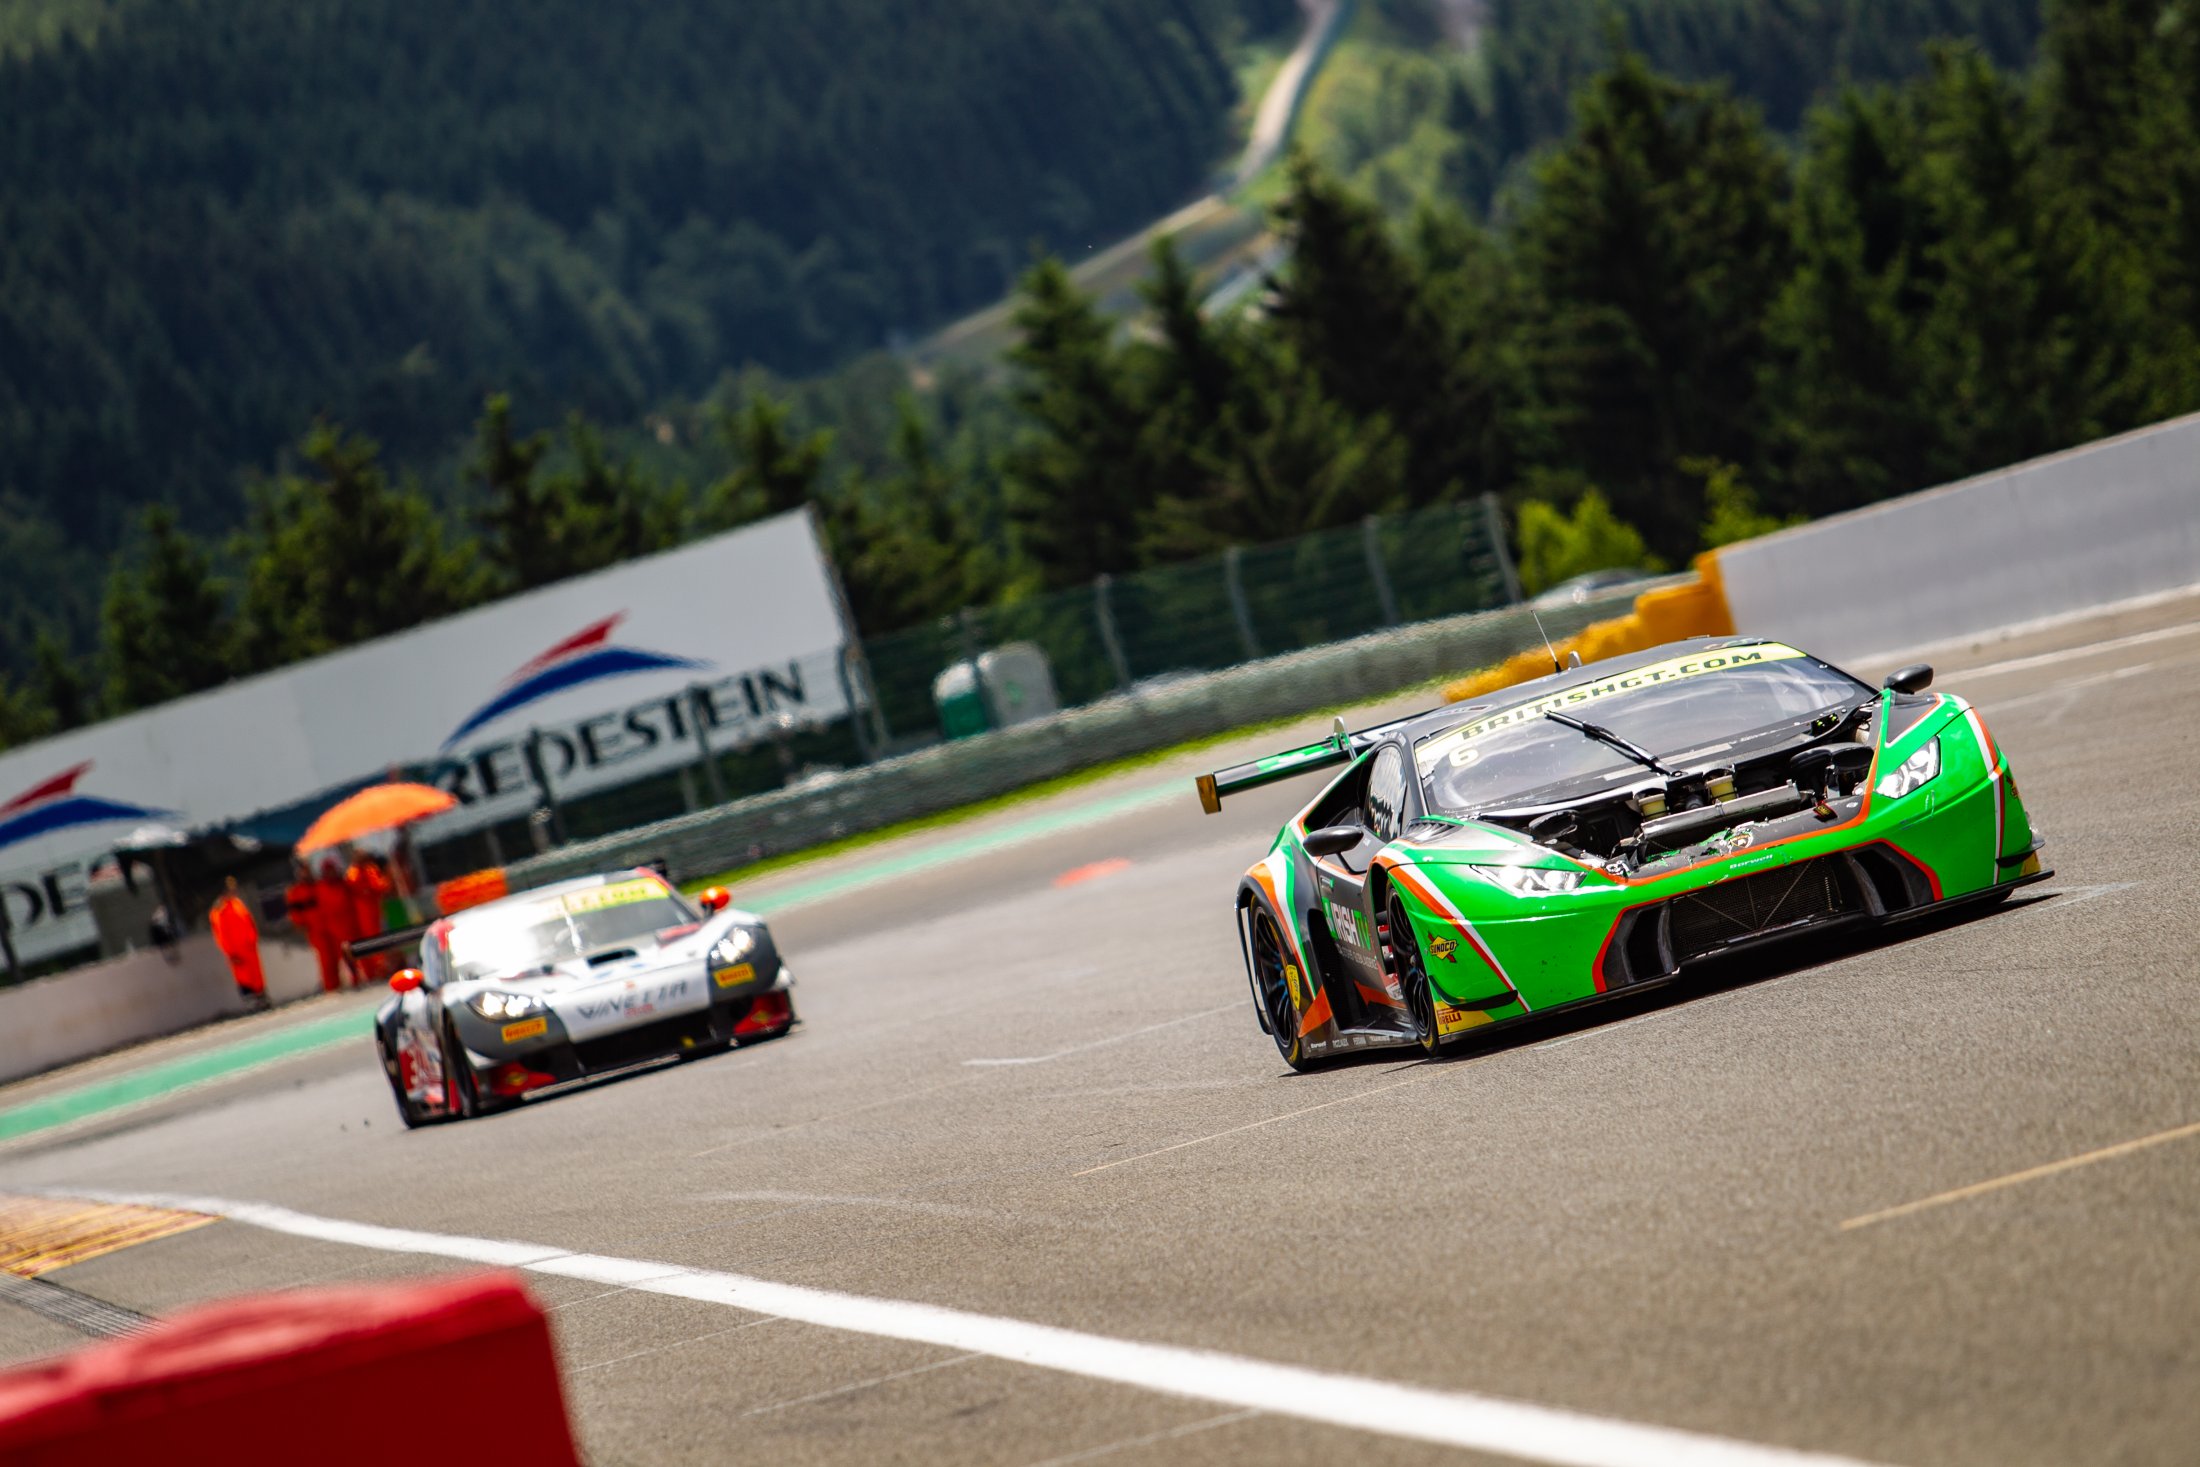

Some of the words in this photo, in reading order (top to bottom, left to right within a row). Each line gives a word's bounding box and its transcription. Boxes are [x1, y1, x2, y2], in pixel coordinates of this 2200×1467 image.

[1461, 651, 1762, 741] BRITISHGT.COM
[431, 657, 809, 806] REDESTEIN
[1448, 745, 1480, 768] 6
[1430, 941, 1455, 954] SUNOCO
